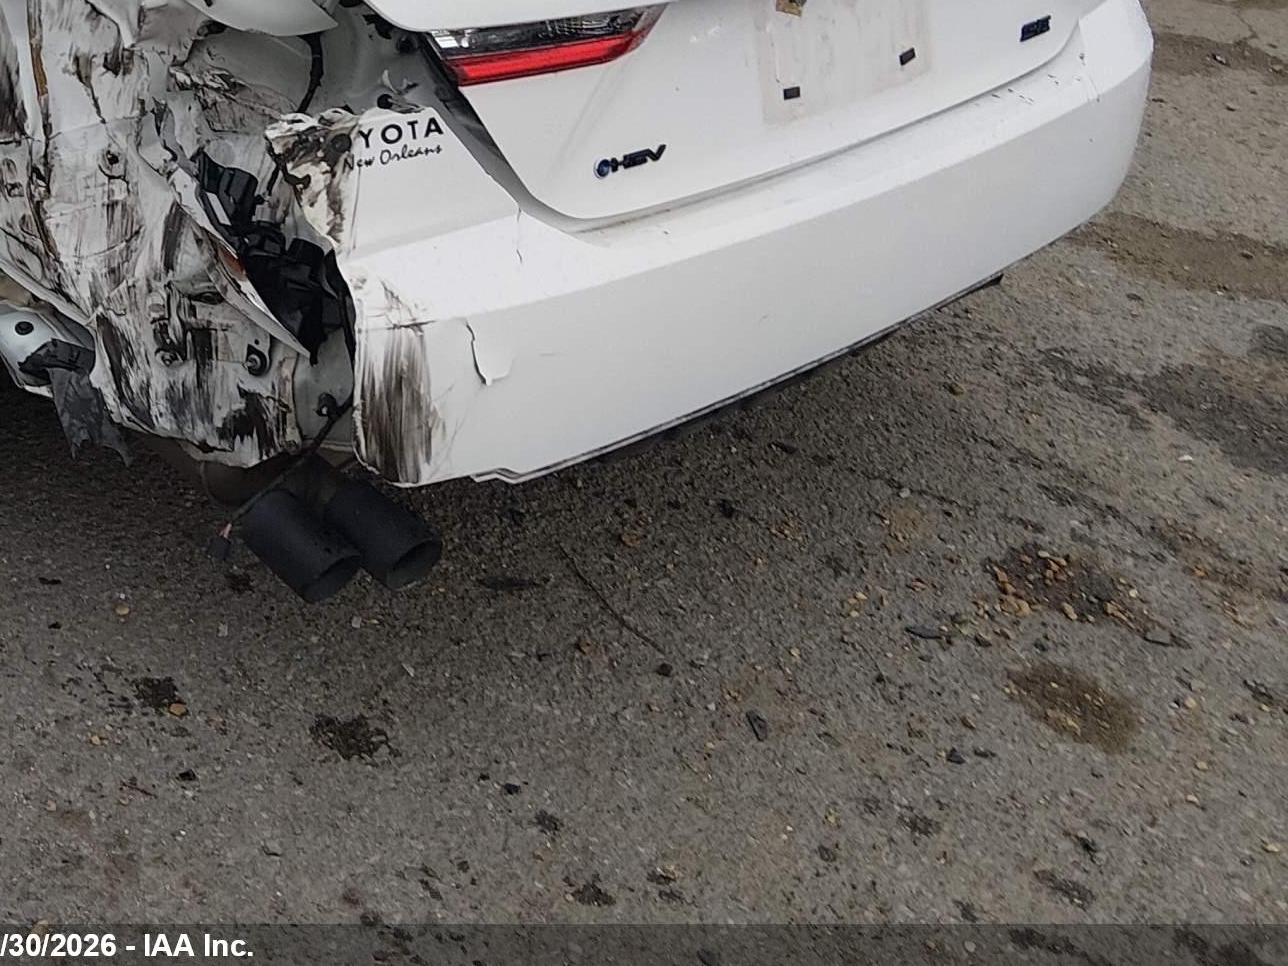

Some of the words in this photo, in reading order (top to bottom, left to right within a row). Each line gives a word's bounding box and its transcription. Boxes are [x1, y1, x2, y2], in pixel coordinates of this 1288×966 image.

[358, 117, 444, 149] YOTA
[343, 153, 376, 171] New
[379, 144, 443, 165] Orleans
